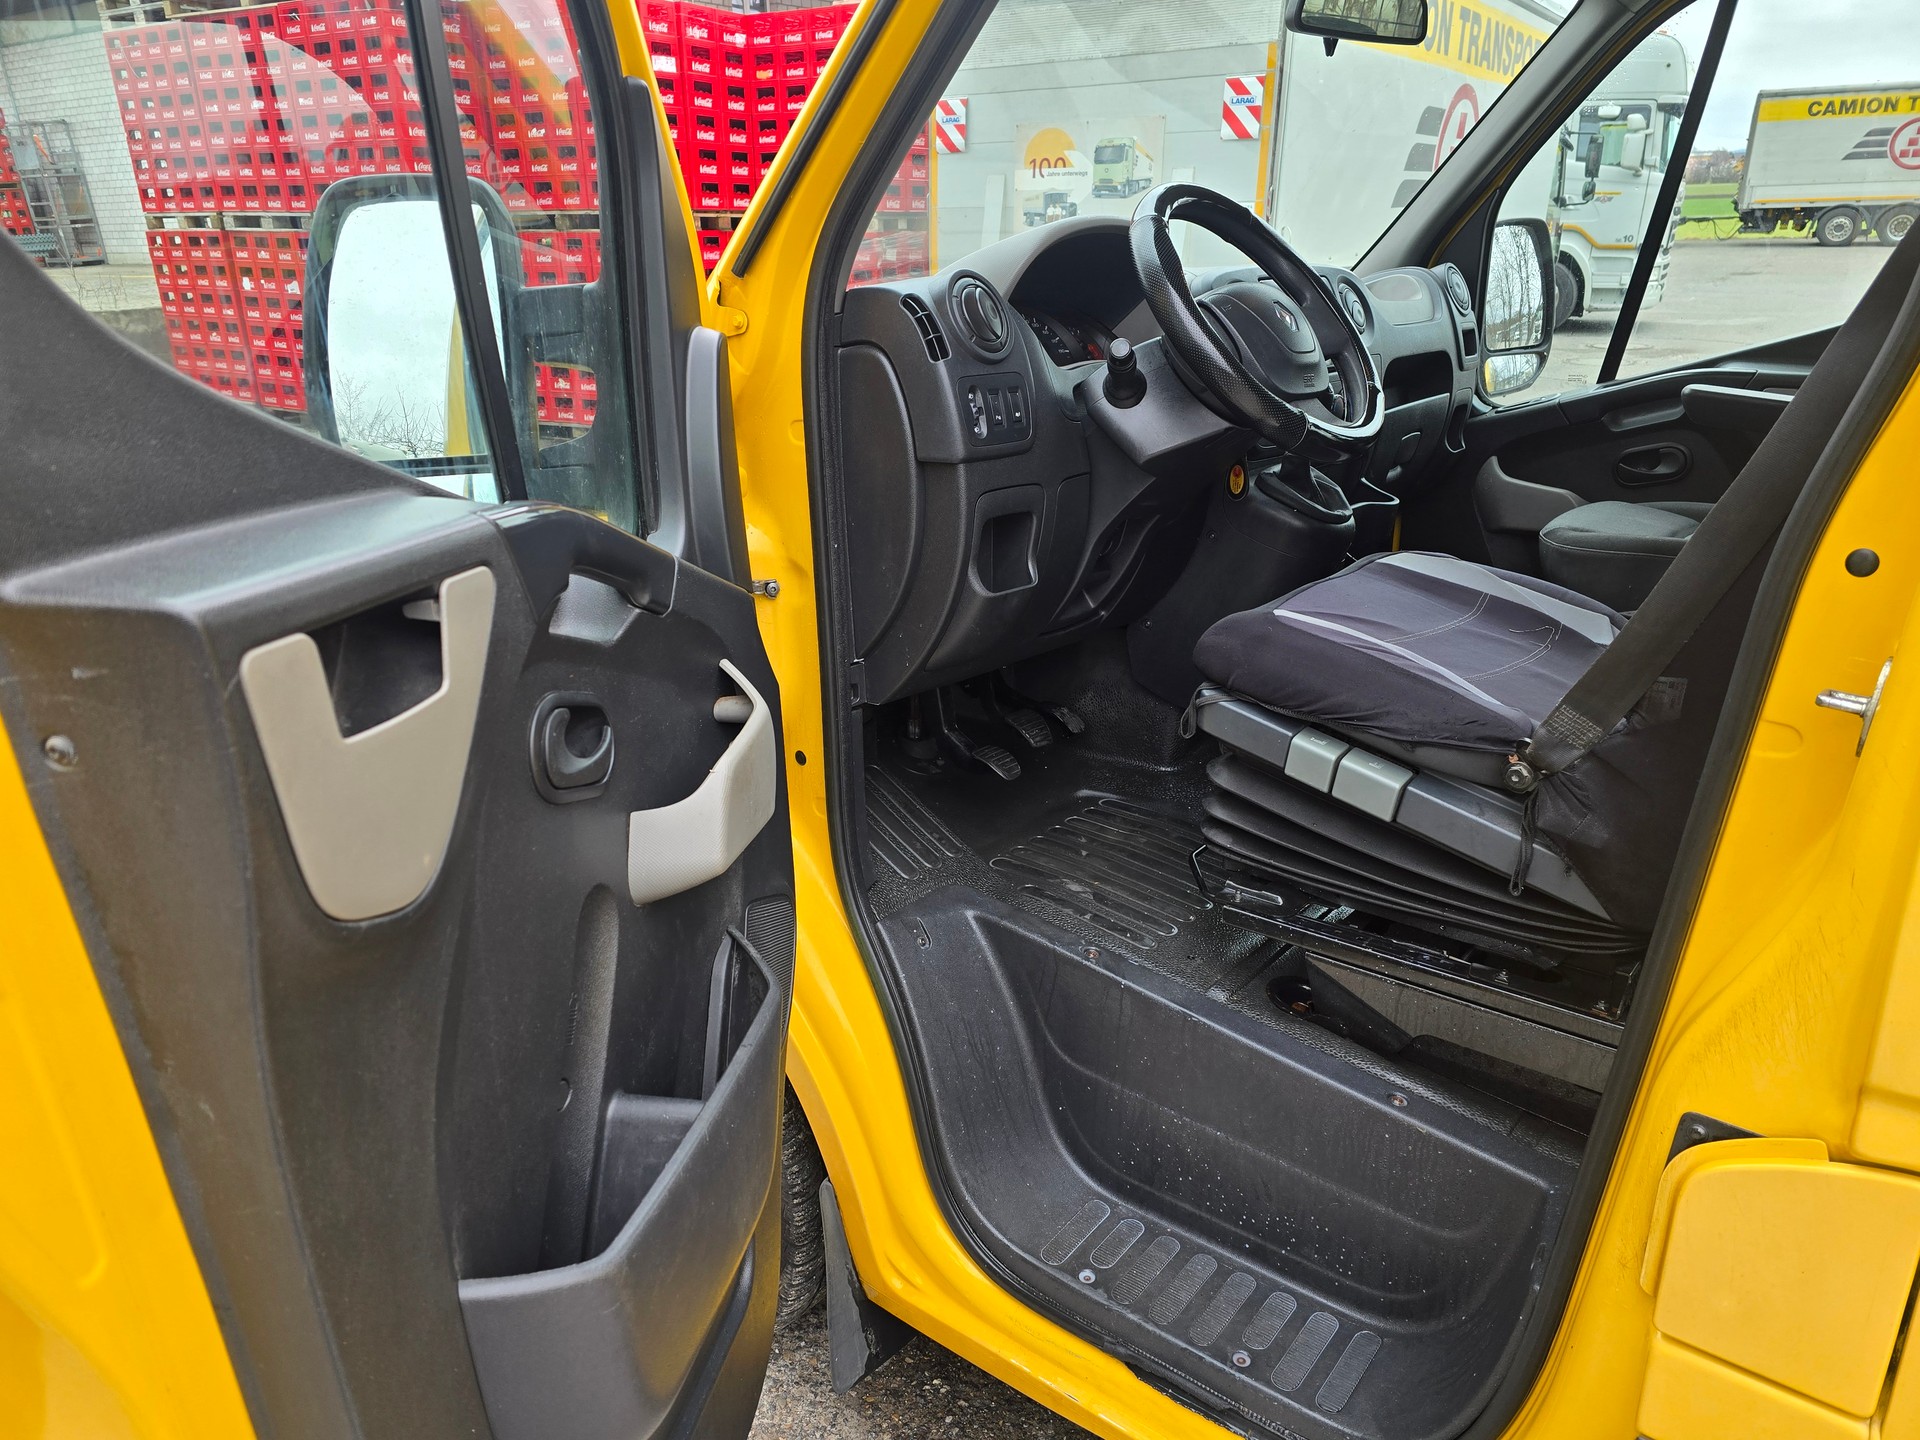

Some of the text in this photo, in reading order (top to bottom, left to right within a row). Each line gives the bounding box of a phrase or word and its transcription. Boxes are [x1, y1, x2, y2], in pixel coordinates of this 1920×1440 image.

[1231, 97, 1256, 105] LARAG
[1808, 96, 1900, 117] CAMION
[942, 116, 960, 124] LARAG
[1029, 157, 1067, 179] 100
[1623, 235, 1634, 243] 10
